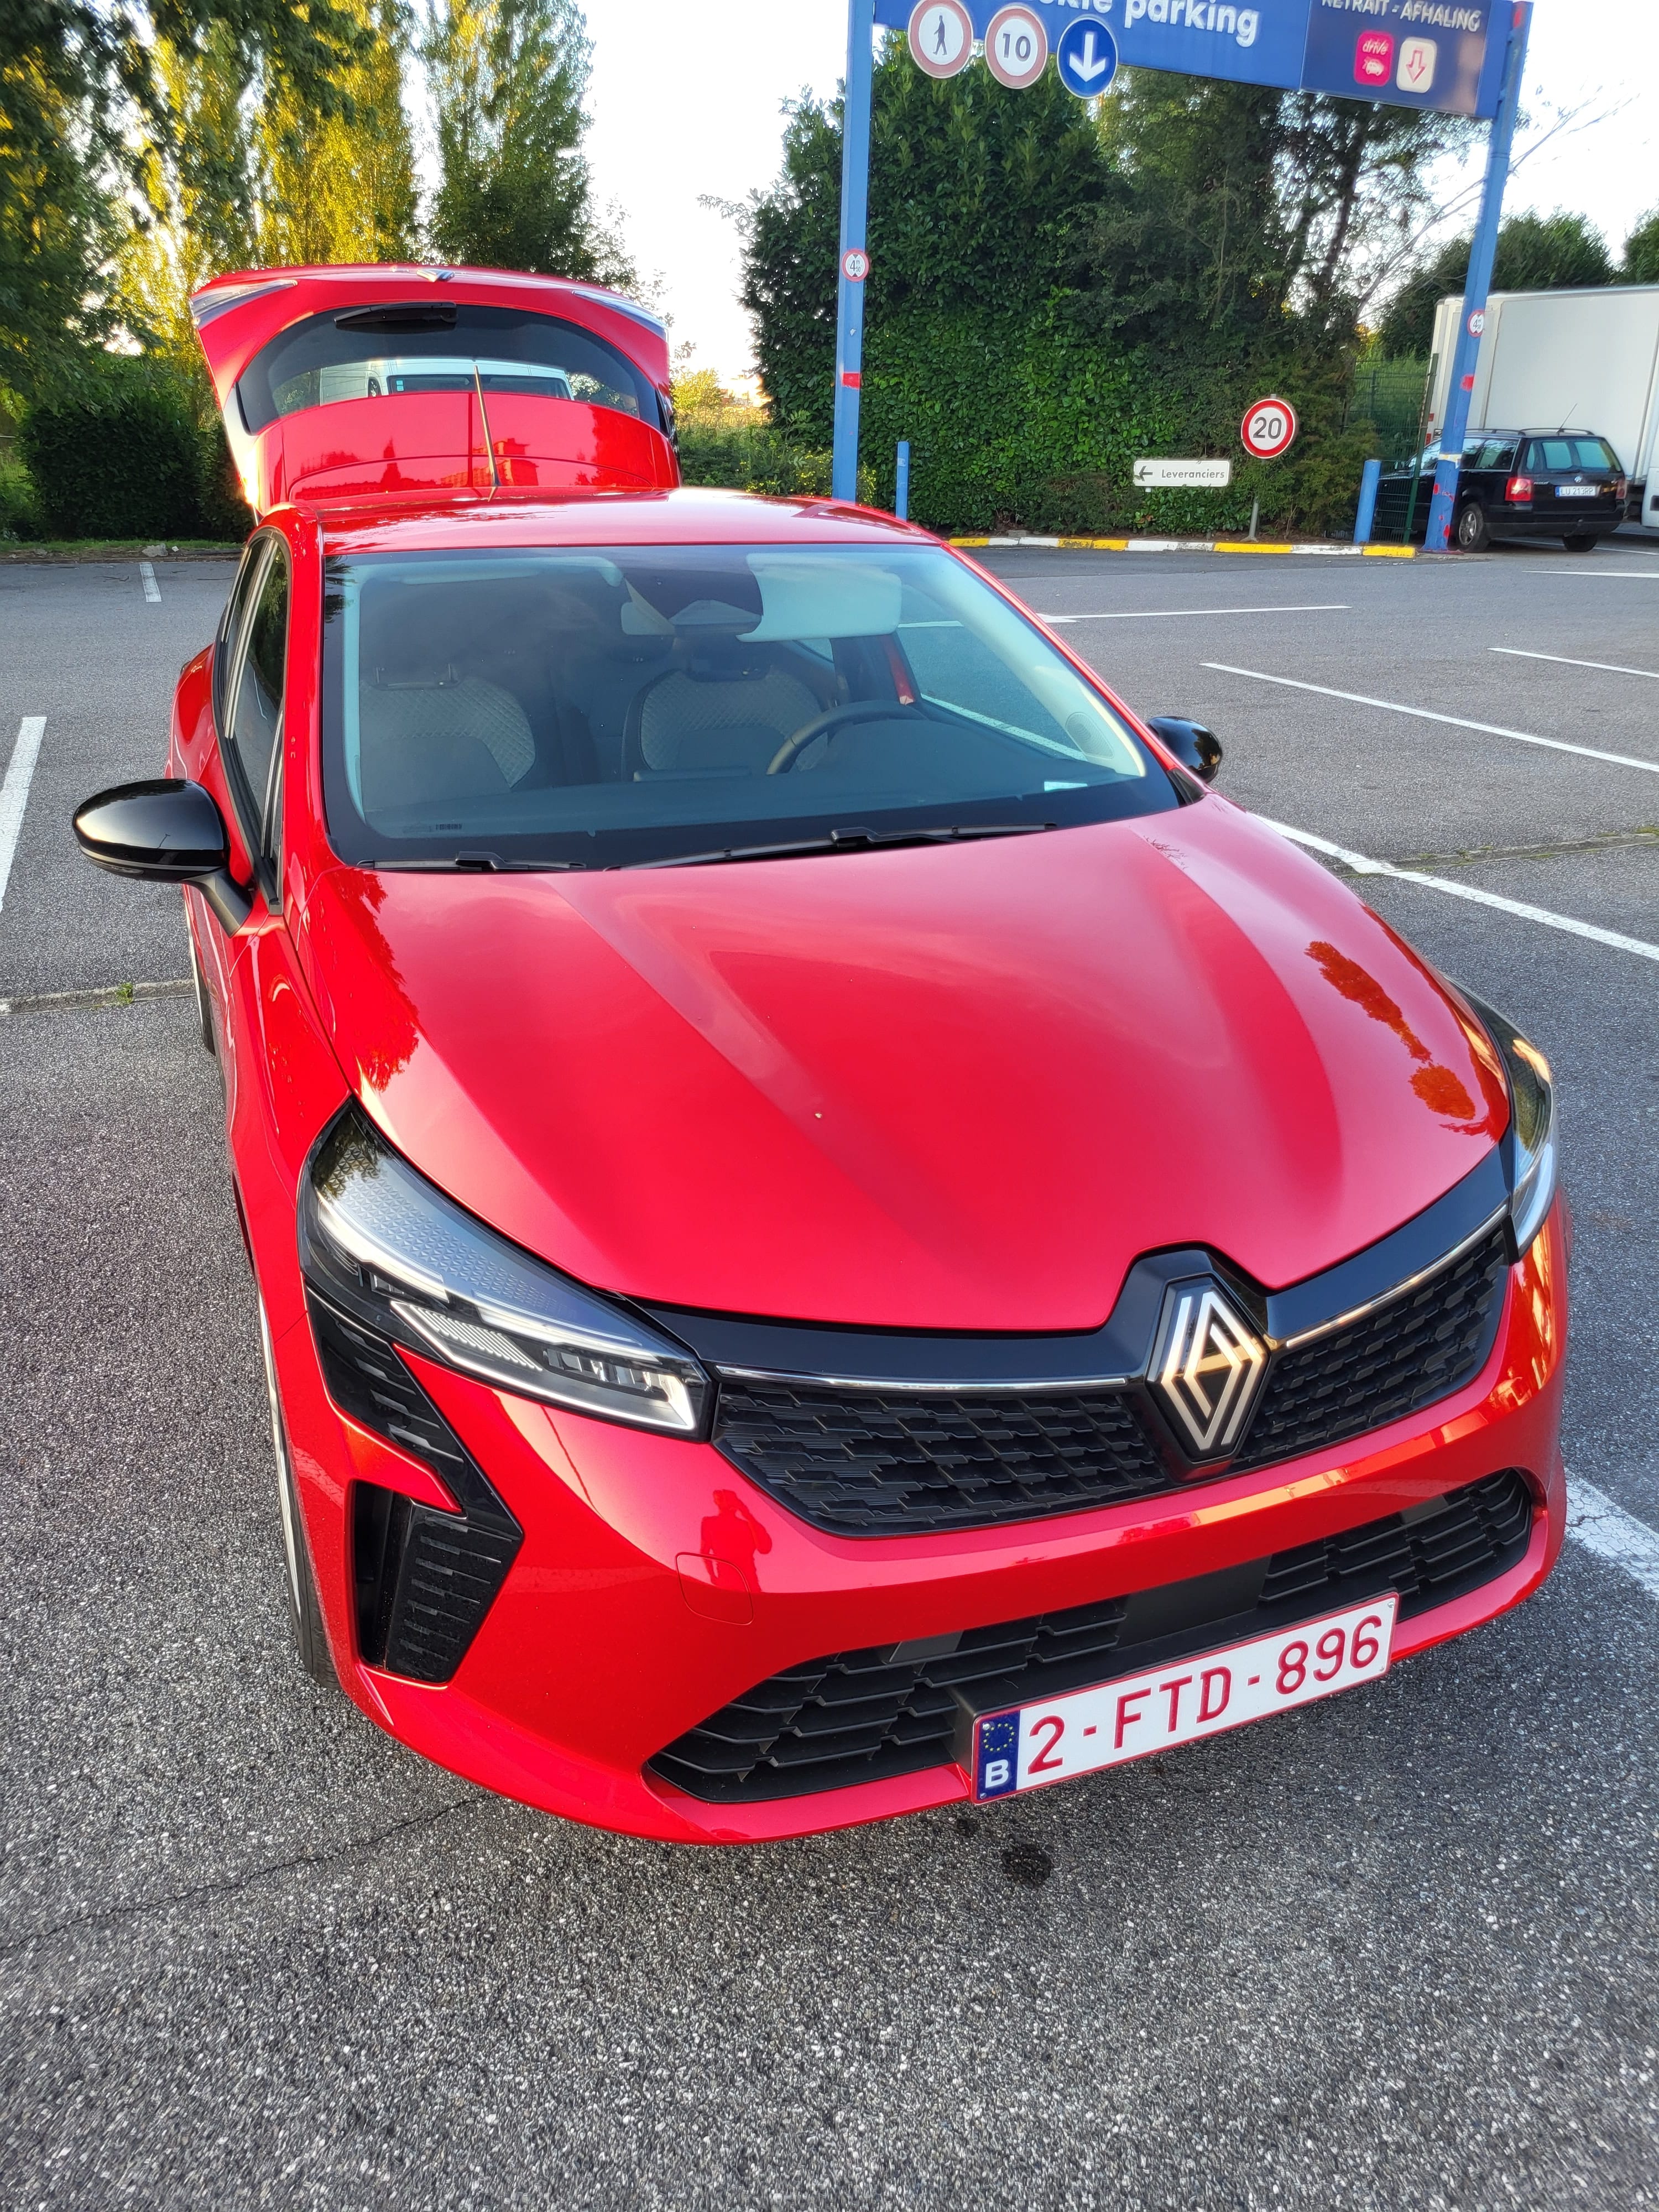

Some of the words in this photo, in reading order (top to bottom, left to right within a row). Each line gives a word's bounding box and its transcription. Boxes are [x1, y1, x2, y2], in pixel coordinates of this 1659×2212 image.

[1124, 0, 1259, 48] parking
[1400, 1, 1481, 32] AFHALING
[1003, 33, 1031, 61] 10
[1362, 38, 1389, 55] drive
[1253, 416, 1282, 439] 20
[1161, 468, 1224, 478] Leveranciers
[1561, 487, 1571, 495] LU
[985, 1759, 1009, 1788] B
